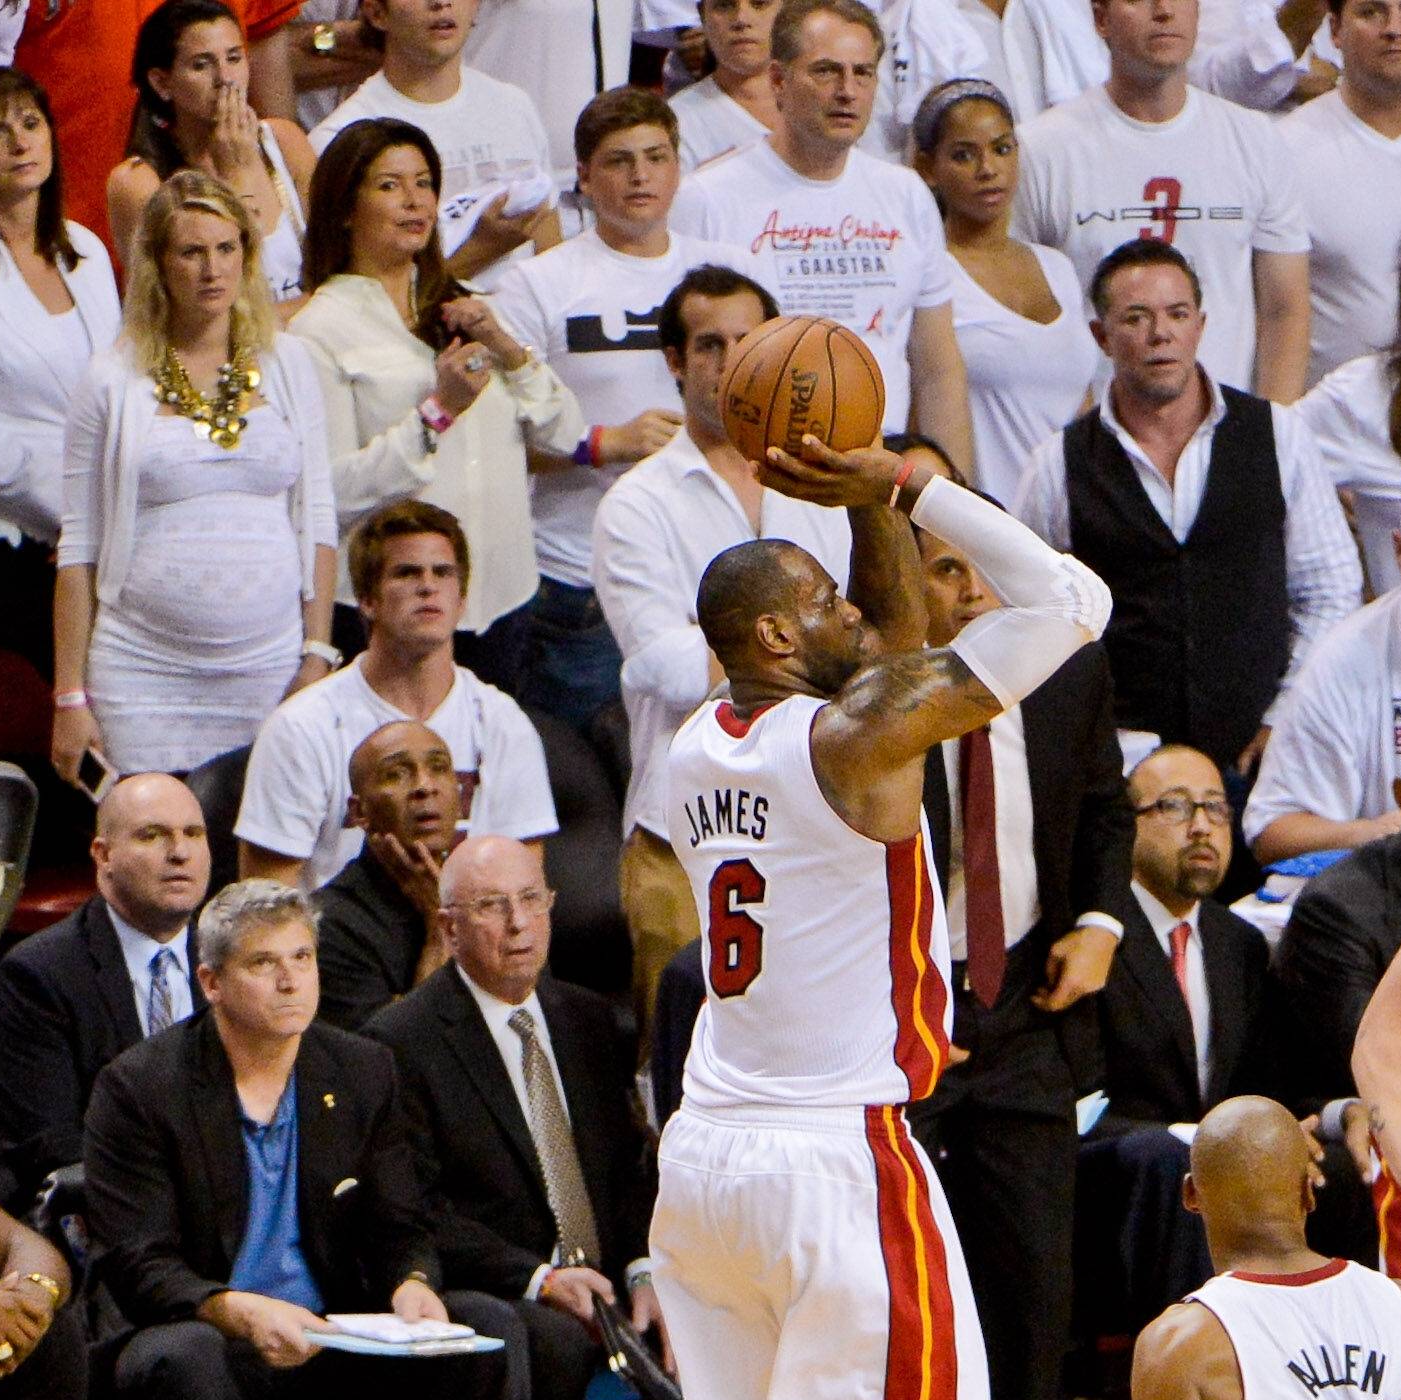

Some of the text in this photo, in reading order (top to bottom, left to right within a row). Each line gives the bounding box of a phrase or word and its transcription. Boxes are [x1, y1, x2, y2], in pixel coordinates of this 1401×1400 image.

[1139, 176, 1182, 247] 3
[684, 788, 770, 849] JAMES
[707, 857, 770, 1002] 6
[1287, 1343, 1386, 1399] ALLEN
